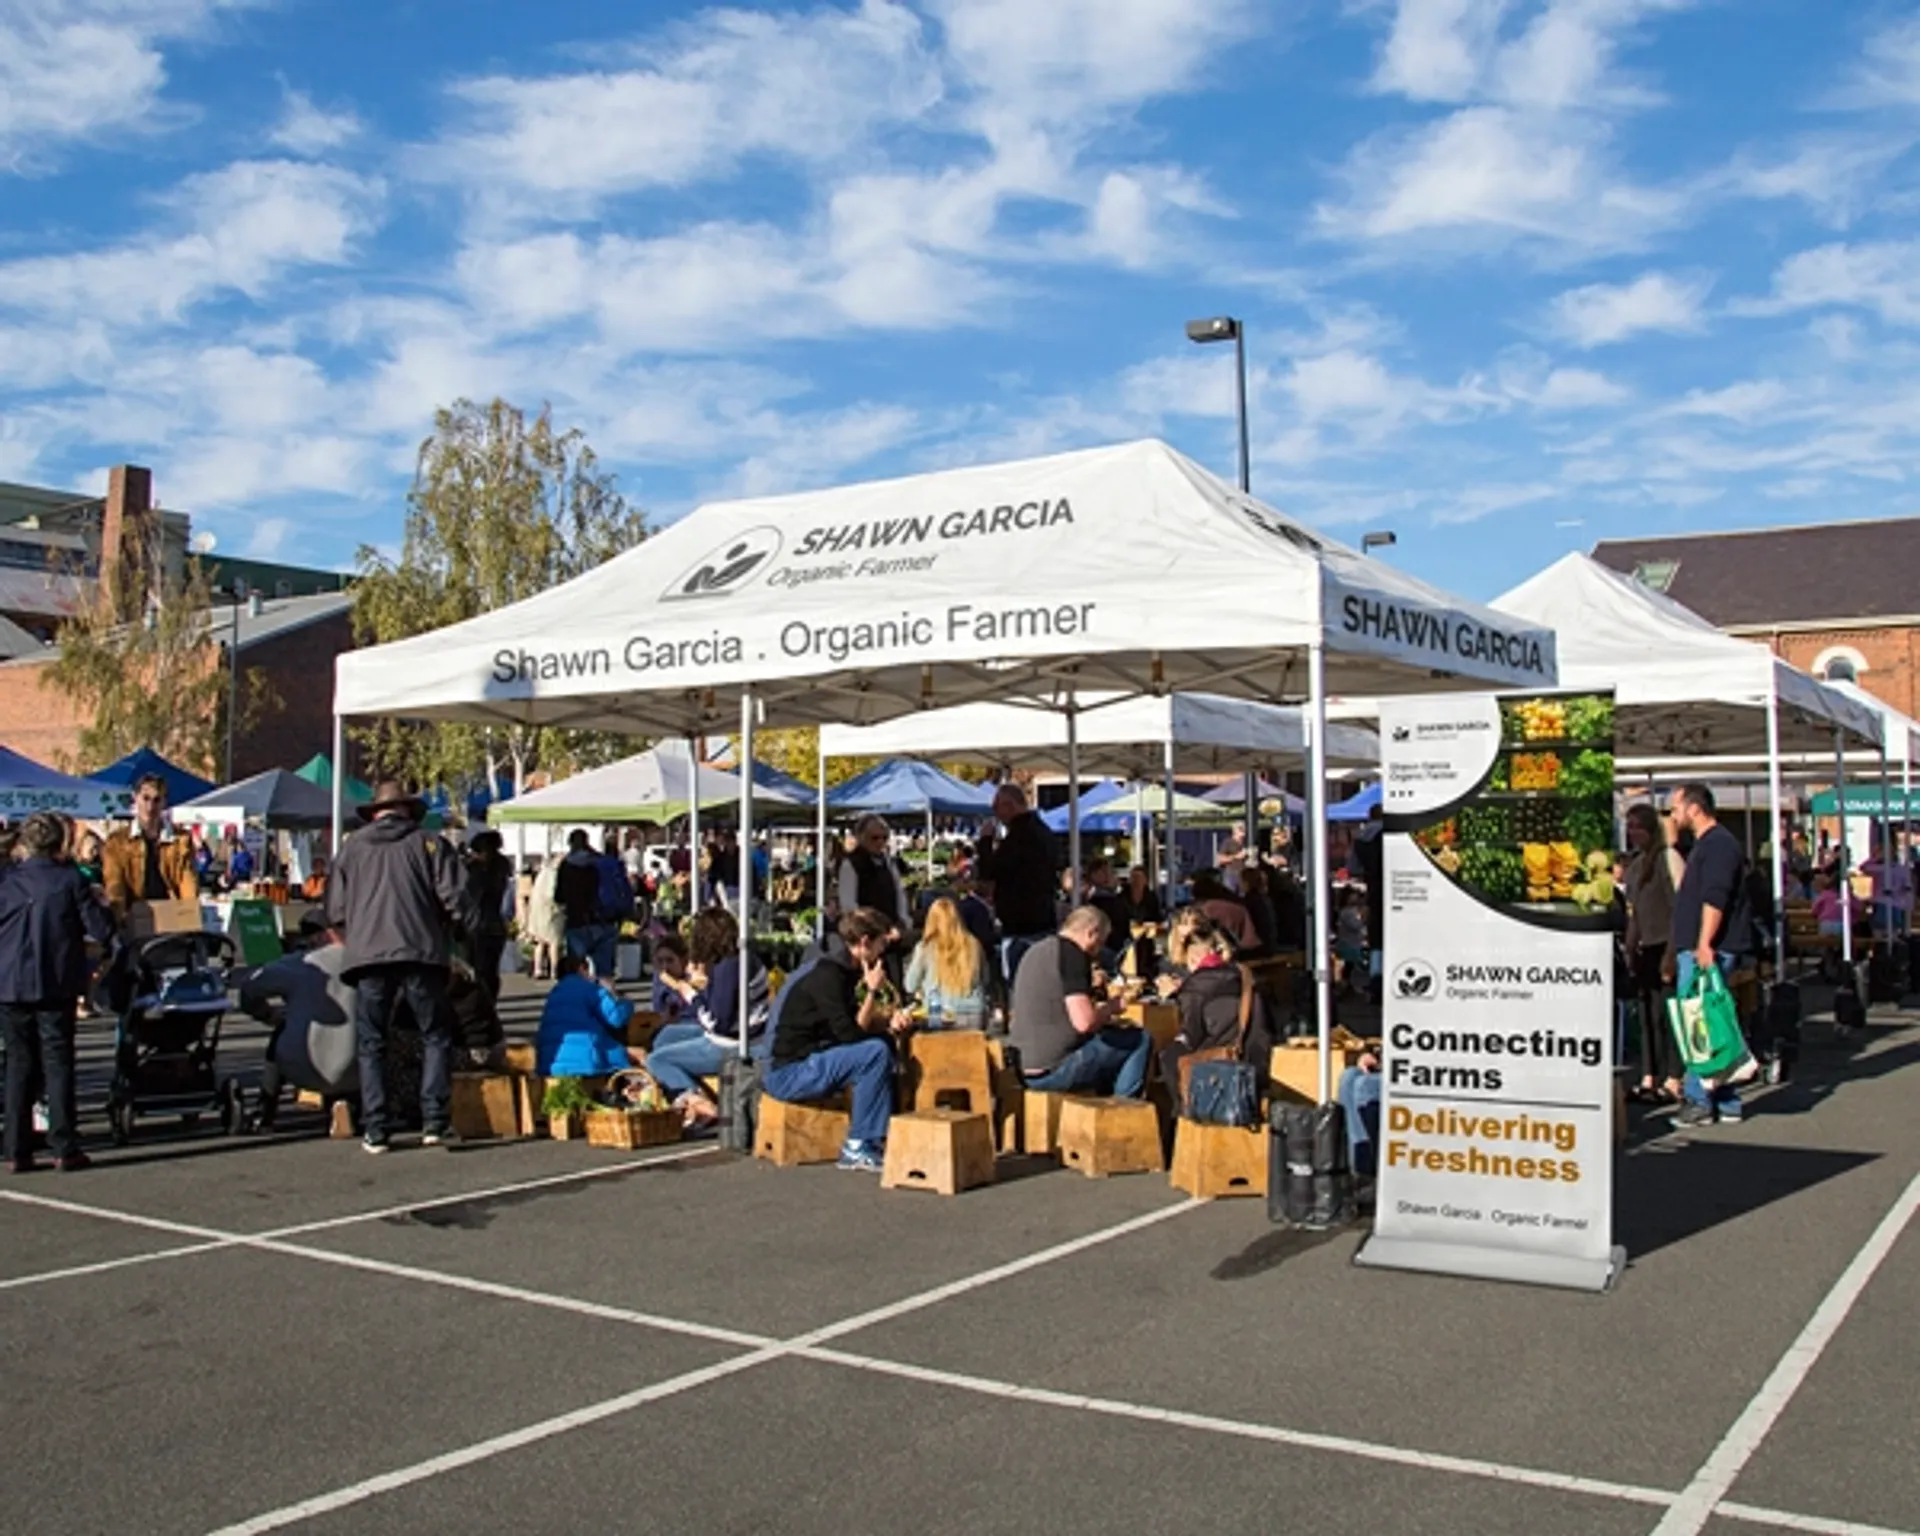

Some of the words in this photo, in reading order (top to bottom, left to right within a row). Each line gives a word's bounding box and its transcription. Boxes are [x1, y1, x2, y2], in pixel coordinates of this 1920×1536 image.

[793, 517, 931, 555] SHAWN
[938, 498, 1075, 538] GARCIA
[766, 562, 852, 589] Organic
[856, 553, 939, 577] Farmer
[491, 649, 610, 684] Shawn
[624, 630, 743, 671] Garcia
[780, 611, 933, 662] Organic
[947, 602, 1096, 642] Farmer
[1343, 595, 1449, 653] SHAWN
[1455, 623, 1544, 674] GARCIA
[1446, 965, 1522, 983] SHAWN
[1526, 967, 1602, 986] GARCIA
[1390, 1024, 1603, 1067] Connecting
[1389, 1058, 1503, 1090] Farms
[1388, 1105, 1577, 1152] Delivering
[1387, 1140, 1581, 1183] Freshness
[1397, 1200, 1437, 1215] Shawn
[1440, 1204, 1482, 1221] Garcia
[1491, 1209, 1540, 1227] Organic
